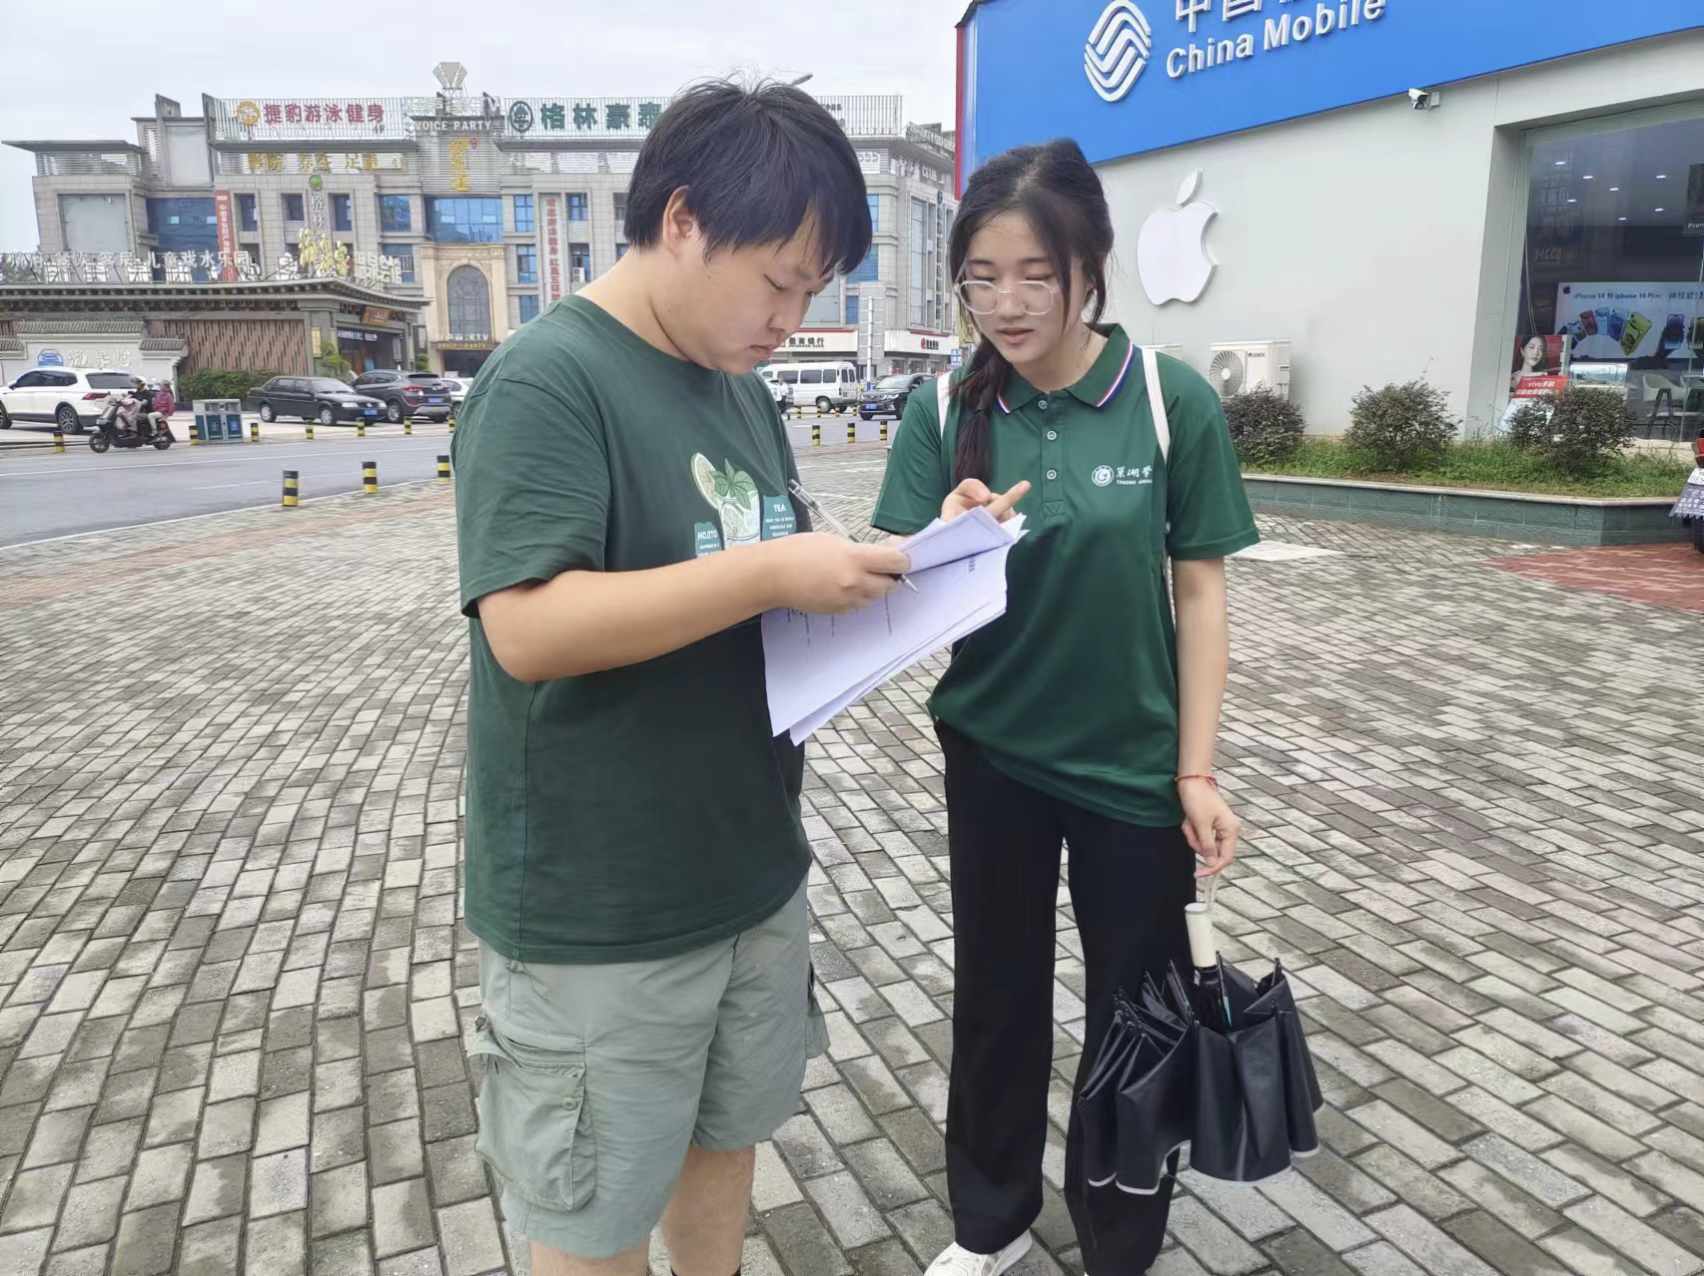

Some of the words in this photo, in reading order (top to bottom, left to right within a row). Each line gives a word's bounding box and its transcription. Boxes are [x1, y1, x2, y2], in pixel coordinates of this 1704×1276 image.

[1166, 33, 1255, 79] China
[1263, 0, 1387, 51] Mobile
[415, 121, 449, 131] VOICE
[453, 120, 492, 131] PARTY
